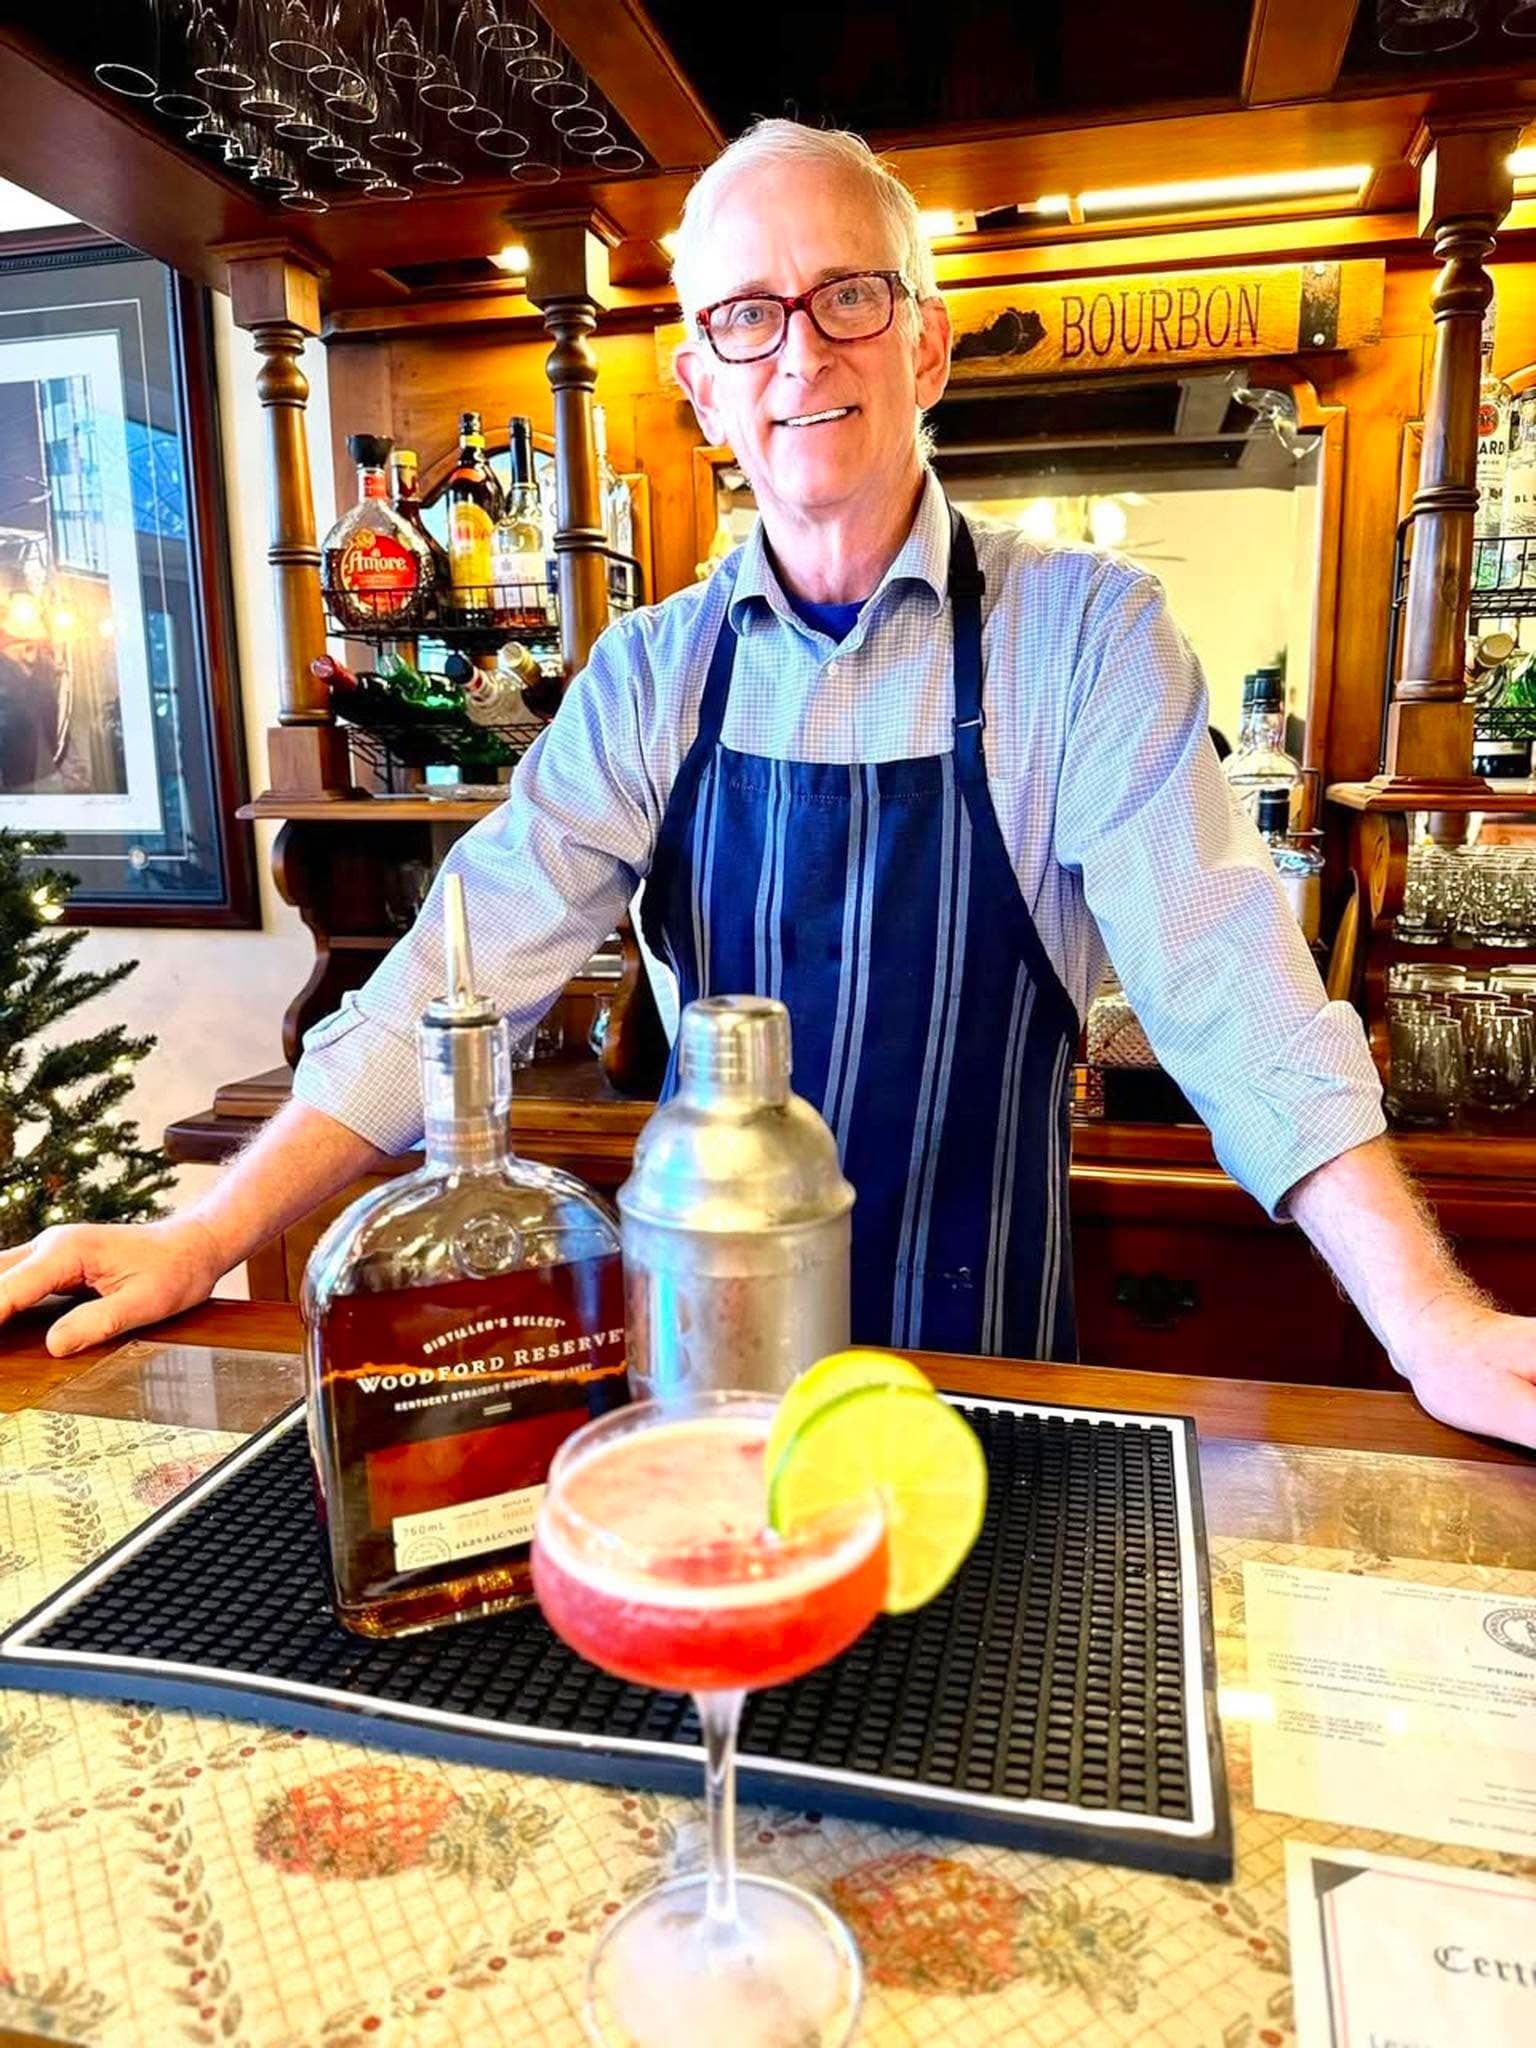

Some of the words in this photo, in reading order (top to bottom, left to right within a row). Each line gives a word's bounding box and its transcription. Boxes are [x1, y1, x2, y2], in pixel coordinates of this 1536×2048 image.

[1061, 284, 1262, 358] BOURBON
[1478, 441, 1505, 455] ARD
[347, 550, 408, 574] Amore
[422, 1317, 508, 1355] DISTILLER'S
[513, 1316, 561, 1328] SELECT
[356, 1356, 505, 1394] WOODFORD
[513, 1329, 622, 1366] RESERVE
[394, 1394, 449, 1412] KENTUCKY
[450, 1384, 500, 1402] STRAIGHT
